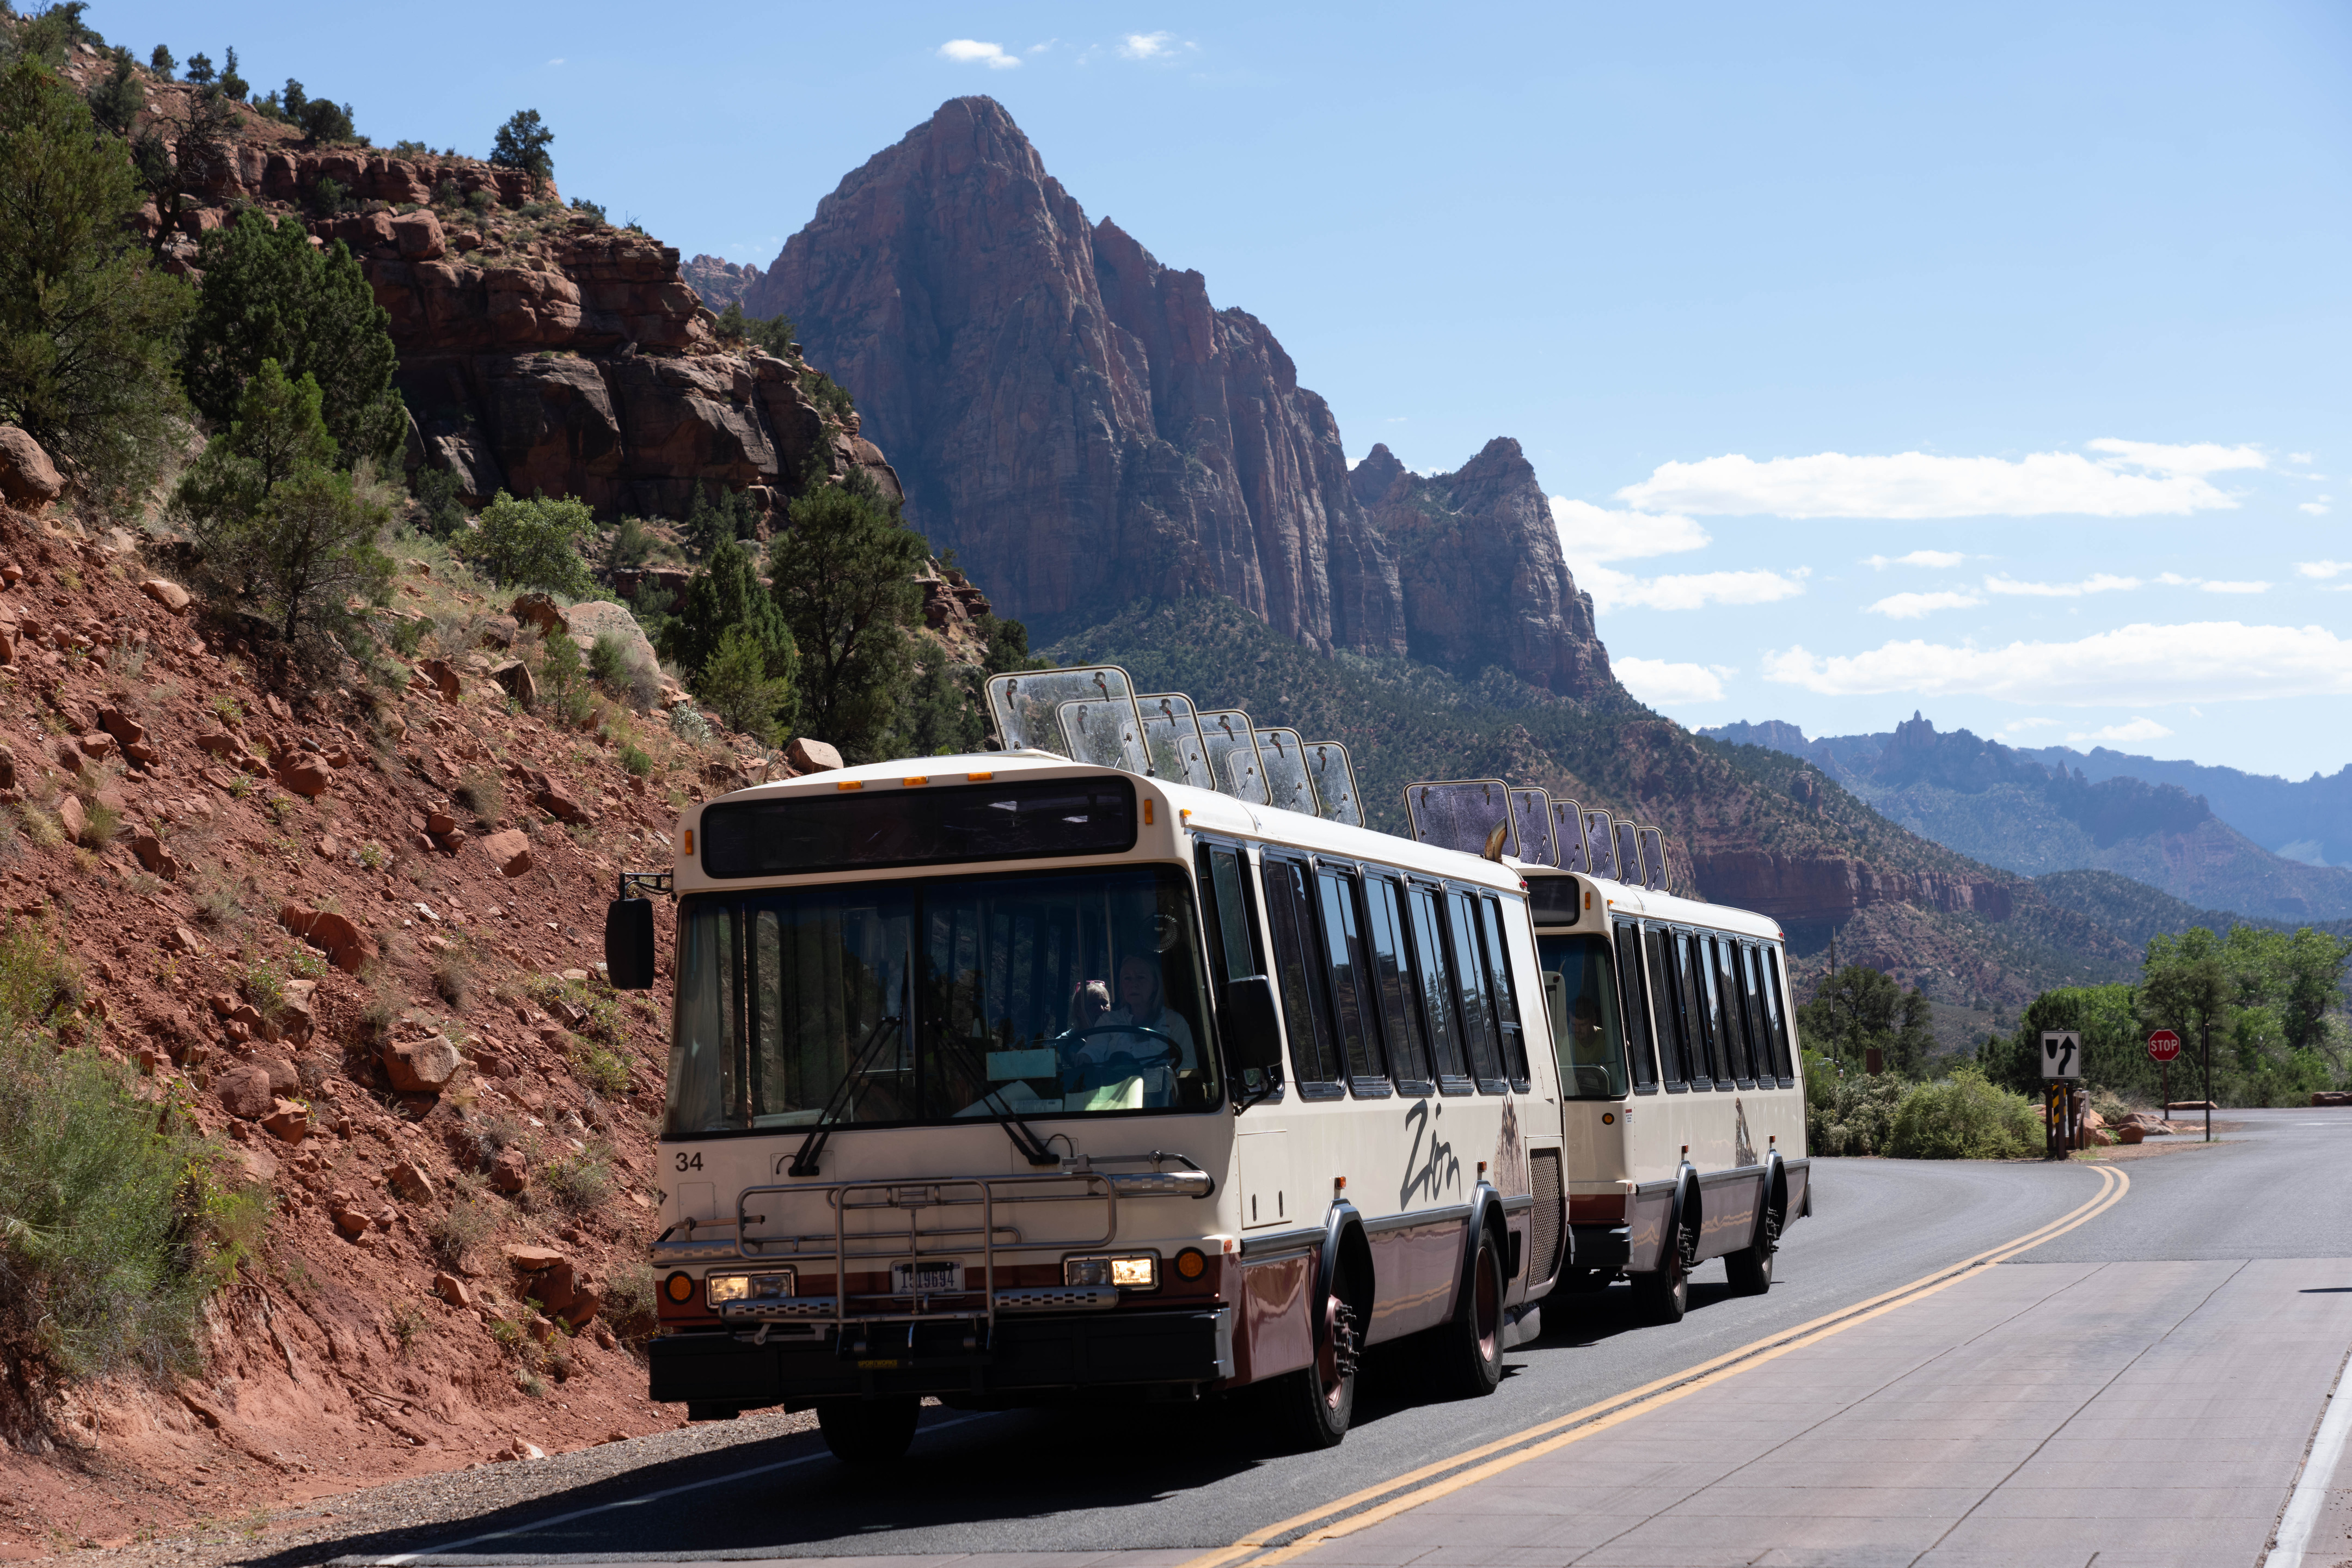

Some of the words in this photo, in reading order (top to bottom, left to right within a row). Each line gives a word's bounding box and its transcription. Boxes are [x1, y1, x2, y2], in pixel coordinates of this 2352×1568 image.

[2151, 1039, 2178, 1052] STOP
[676, 1152, 704, 1172] 34
[1400, 1098, 1461, 1212] Zion
